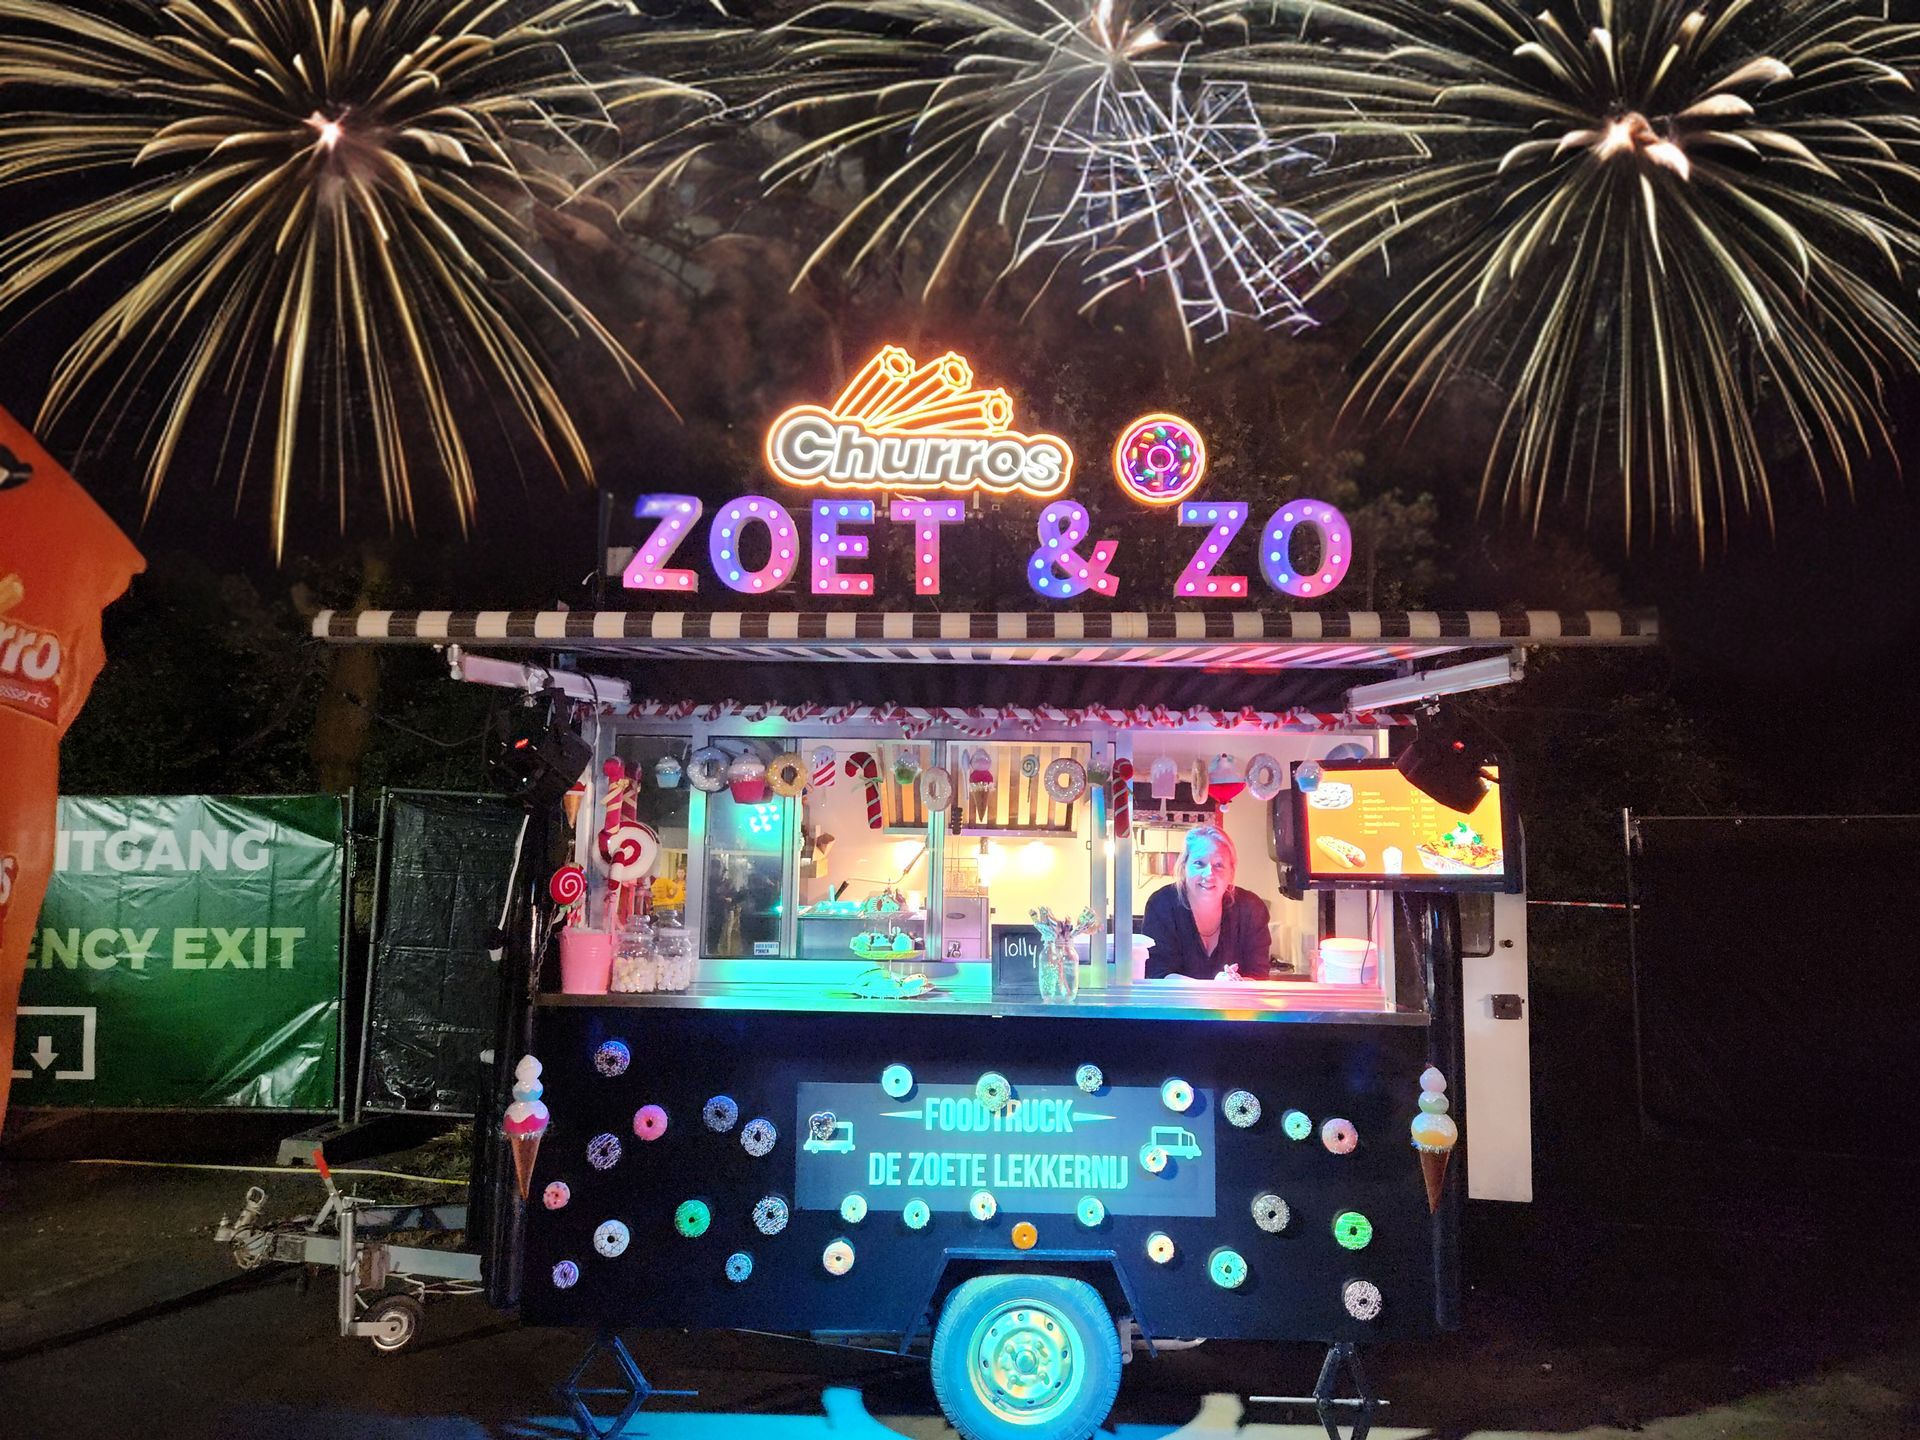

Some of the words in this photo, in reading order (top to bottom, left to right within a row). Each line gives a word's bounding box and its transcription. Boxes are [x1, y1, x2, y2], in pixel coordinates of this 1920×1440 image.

[777, 415, 1064, 487] Churros
[622, 494, 966, 597] ZOET
[1027, 500, 1121, 600] &
[1174, 500, 1353, 600] ZO
[172, 927, 306, 969] EXIT
[1004, 937, 1037, 968] lolly
[868, 1152, 901, 1186] DE
[907, 1151, 987, 1188] ZOETE
[993, 1153, 1129, 1190] LEKKERNIJ
